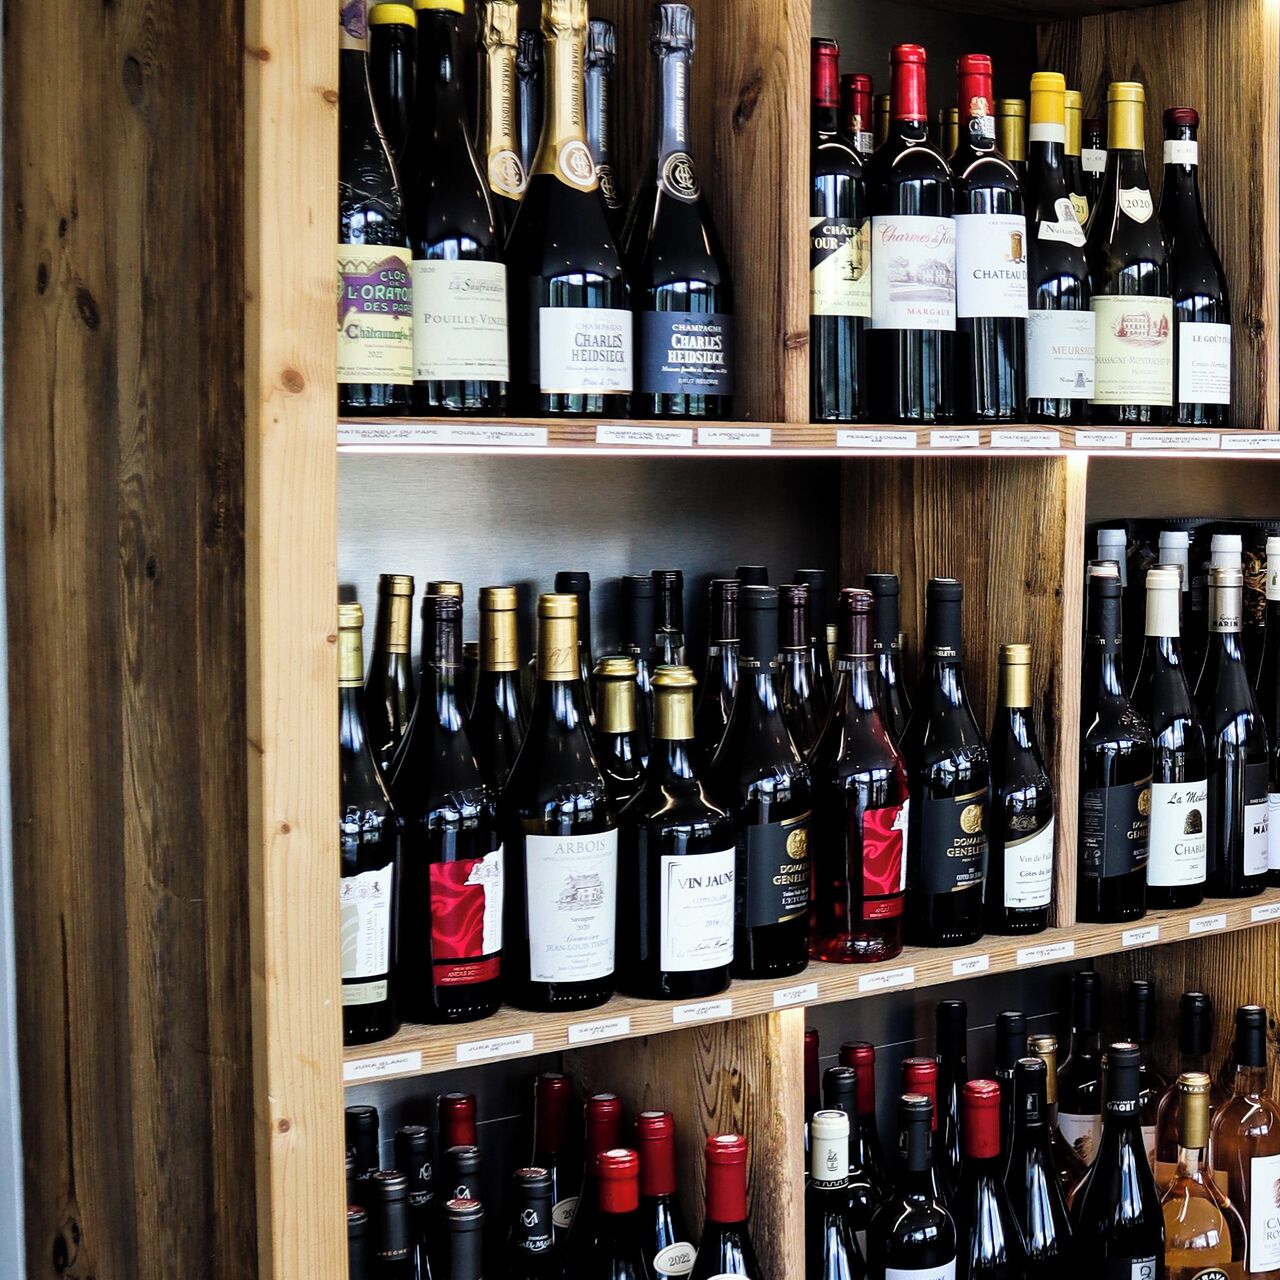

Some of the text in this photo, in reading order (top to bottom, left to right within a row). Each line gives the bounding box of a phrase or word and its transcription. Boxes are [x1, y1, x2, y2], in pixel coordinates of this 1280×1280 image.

[570, 42, 580, 127] CHARLES HEIDSIECK
[501, 56, 511, 138] CHARLES HEIDSIECK
[675, 61, 685, 143] CHARLES HEIDSIECK
[1125, 198, 1150, 209] 2020
[379, 270, 406, 283] CLOS
[972, 268, 1021, 280] CHATEAU
[363, 301, 388, 312] DES
[906, 306, 951, 317] MARGAUX
[671, 324, 723, 333] CHAMPAGNE
[574, 332, 623, 349] CHARLES
[671, 333, 722, 350] CHARLES
[571, 349, 625, 363] HEIDSIECK
[667, 350, 725, 365] HEIDSIECK
[450, 430, 536, 439] POUILLY VINZELLES
[603, 429, 652, 438] CHAMPAGNE
[553, 838, 606, 856] ARBOIS
[677, 877, 702, 891] VIN
[1106, 1099, 1137, 1112] GAGET
[667, 1251, 691, 1268] 2022
